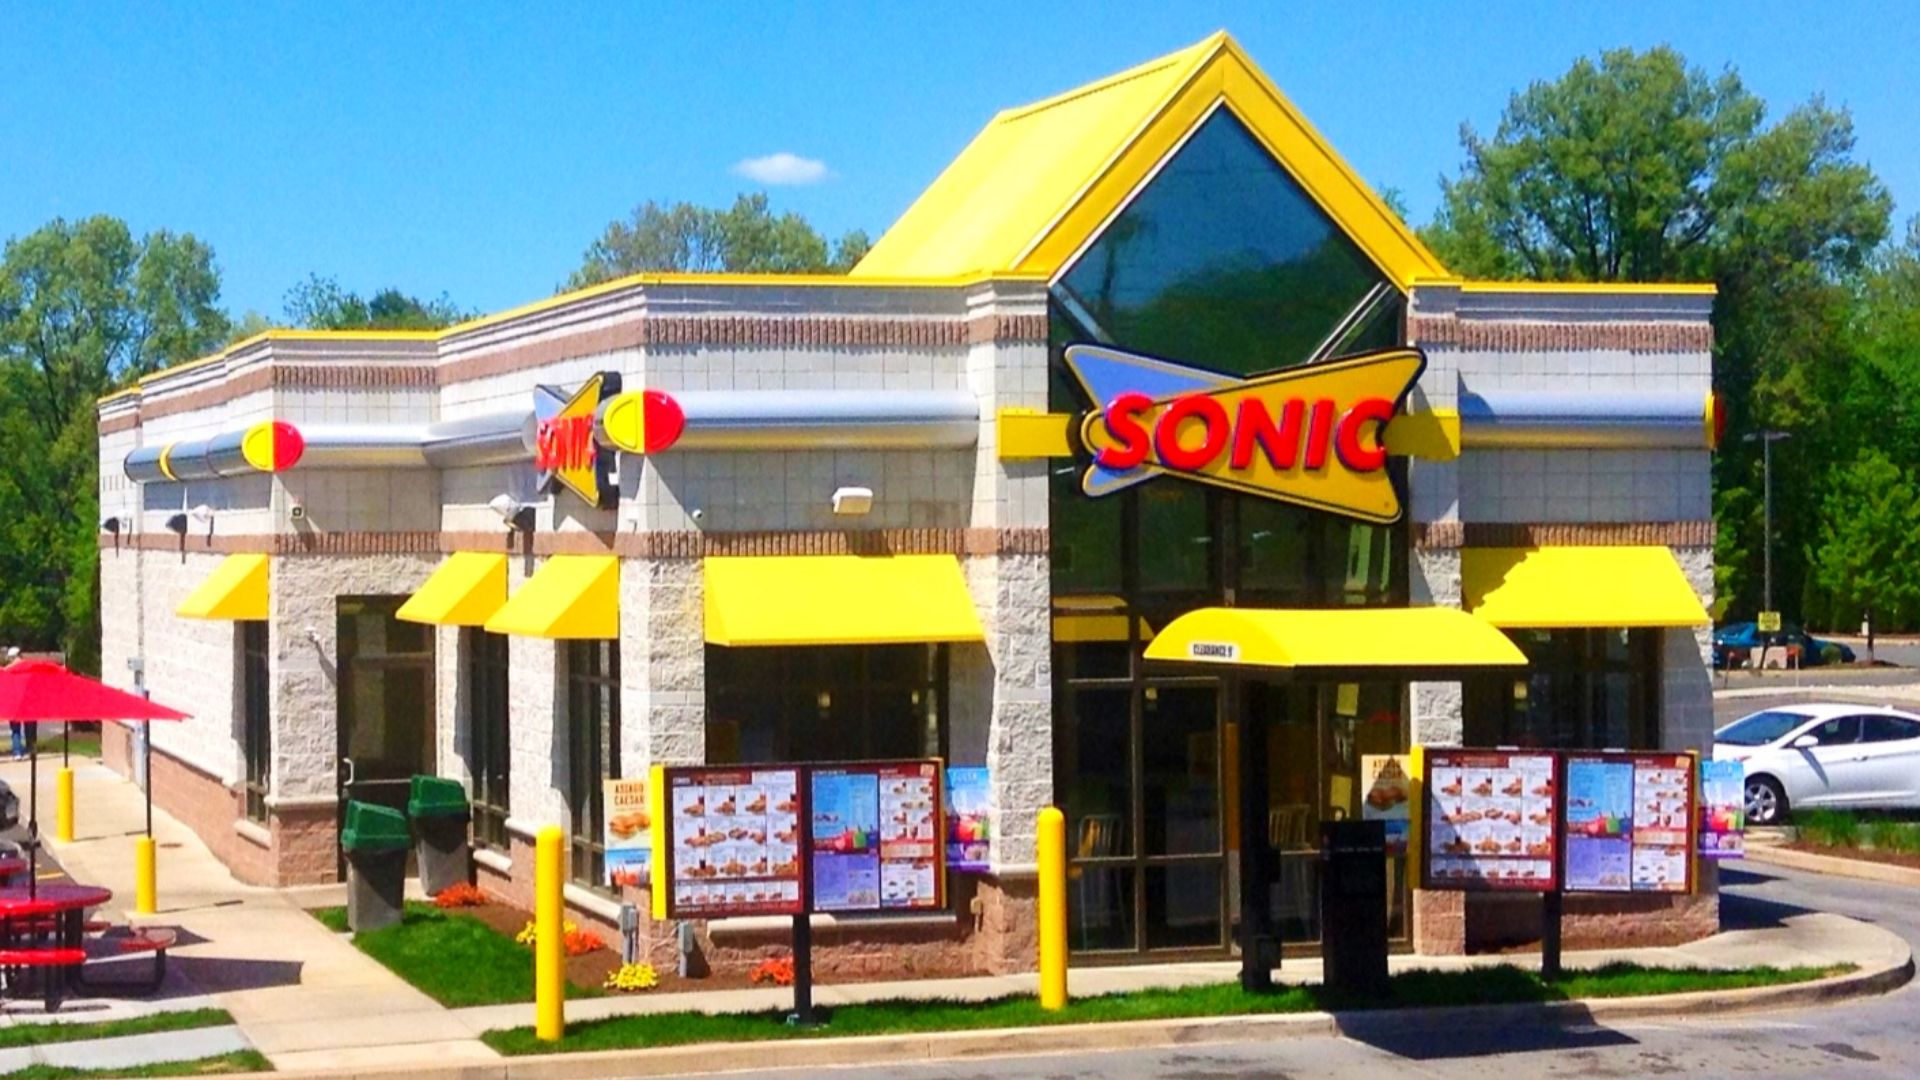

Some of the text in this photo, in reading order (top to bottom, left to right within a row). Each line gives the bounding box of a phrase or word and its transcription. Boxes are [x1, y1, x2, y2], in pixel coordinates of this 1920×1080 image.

[535, 415, 595, 471] SONIC
[1094, 392, 1393, 471] SONIC
[614, 795, 645, 806] CAESAR
